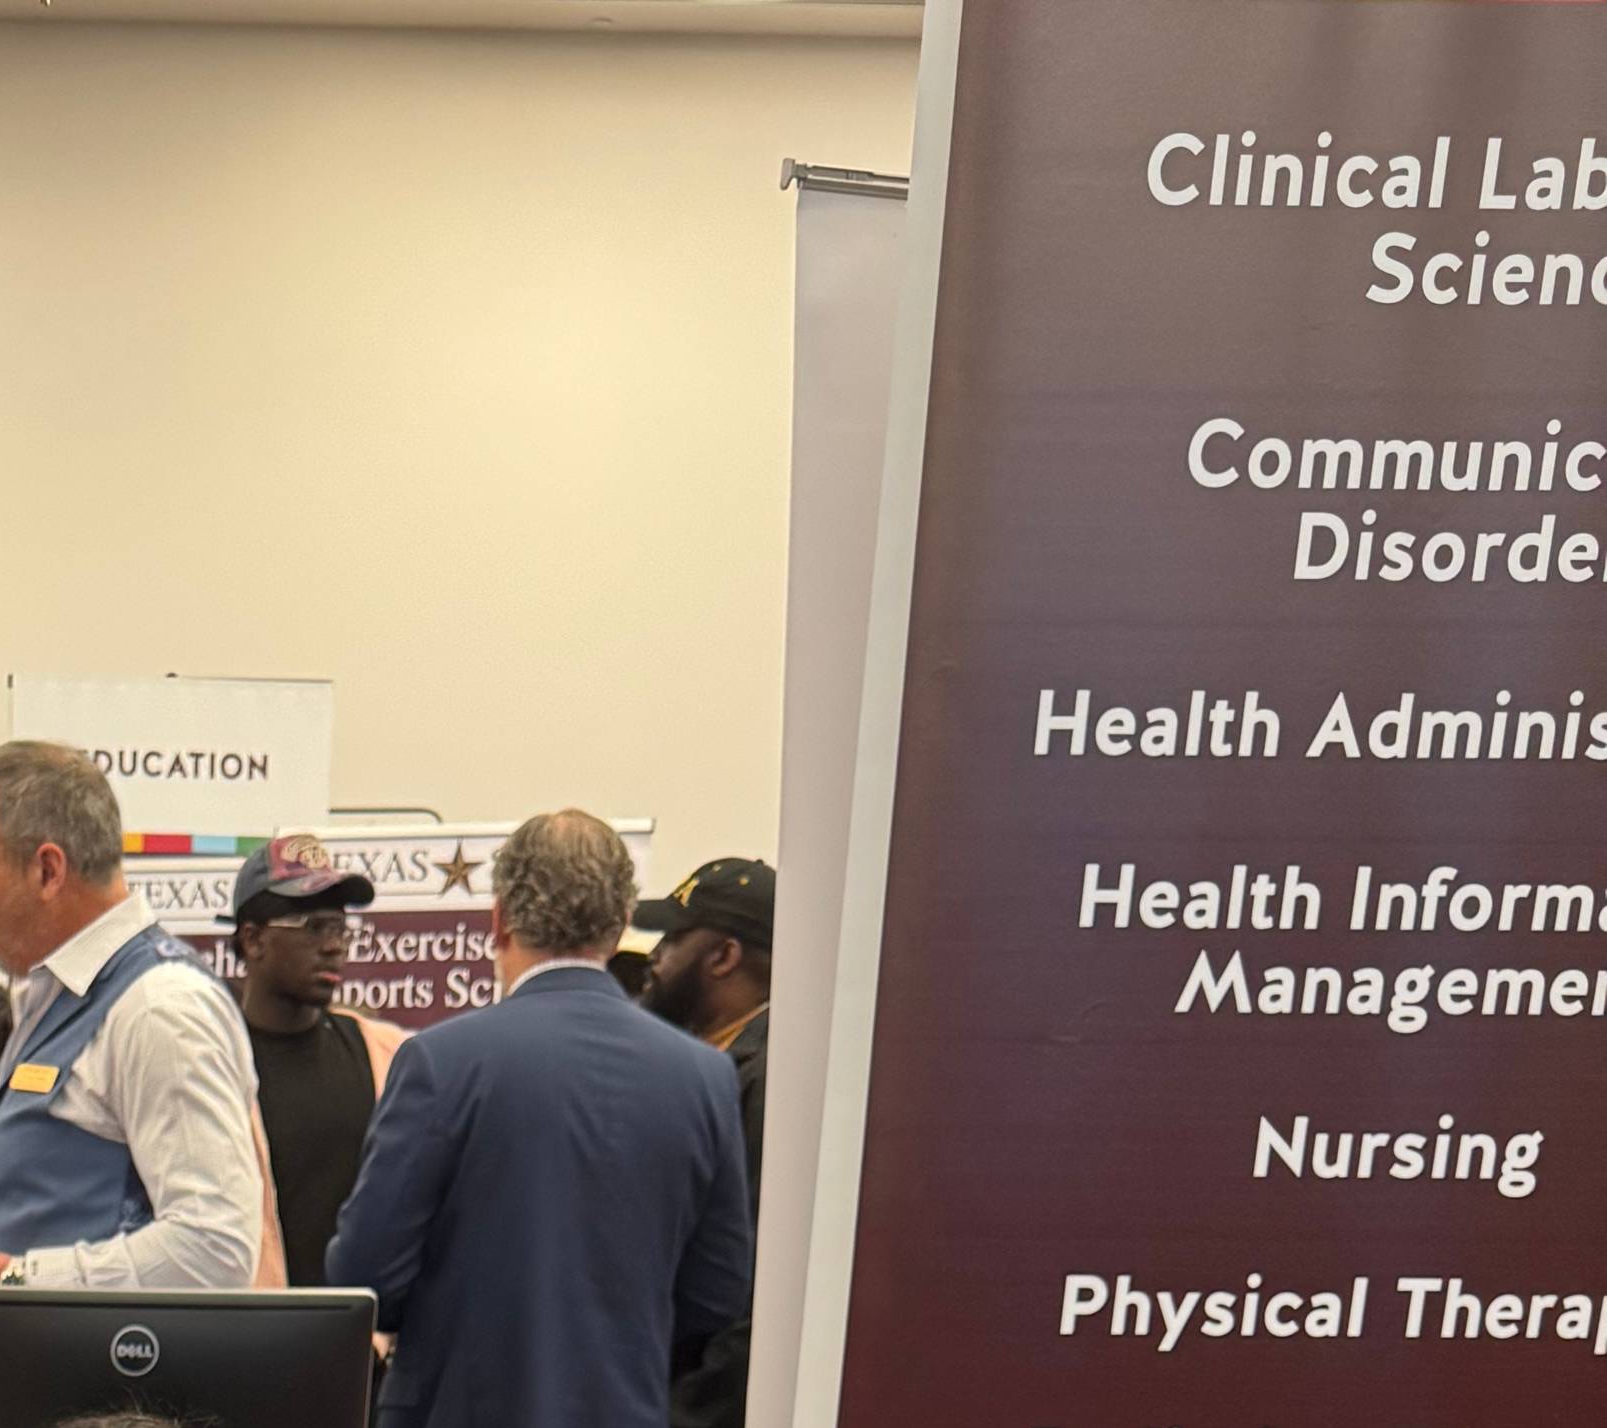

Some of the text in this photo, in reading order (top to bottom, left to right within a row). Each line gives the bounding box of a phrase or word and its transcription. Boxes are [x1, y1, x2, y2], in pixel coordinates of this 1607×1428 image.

[1147, 130, 1451, 209] Clinical
[1188, 417, 1607, 492] Communic
[1293, 508, 1607, 583] Disorde
[1034, 689, 1280, 757] Health
[86, 749, 270, 780] DUCATION
[332, 850, 431, 882] EXAS
[1079, 863, 1607, 932] Health Inform
[1253, 1114, 1544, 1198] Nursing
[1059, 1272, 1369, 1352] Physical
[116, 1342, 154, 1359] DELL
